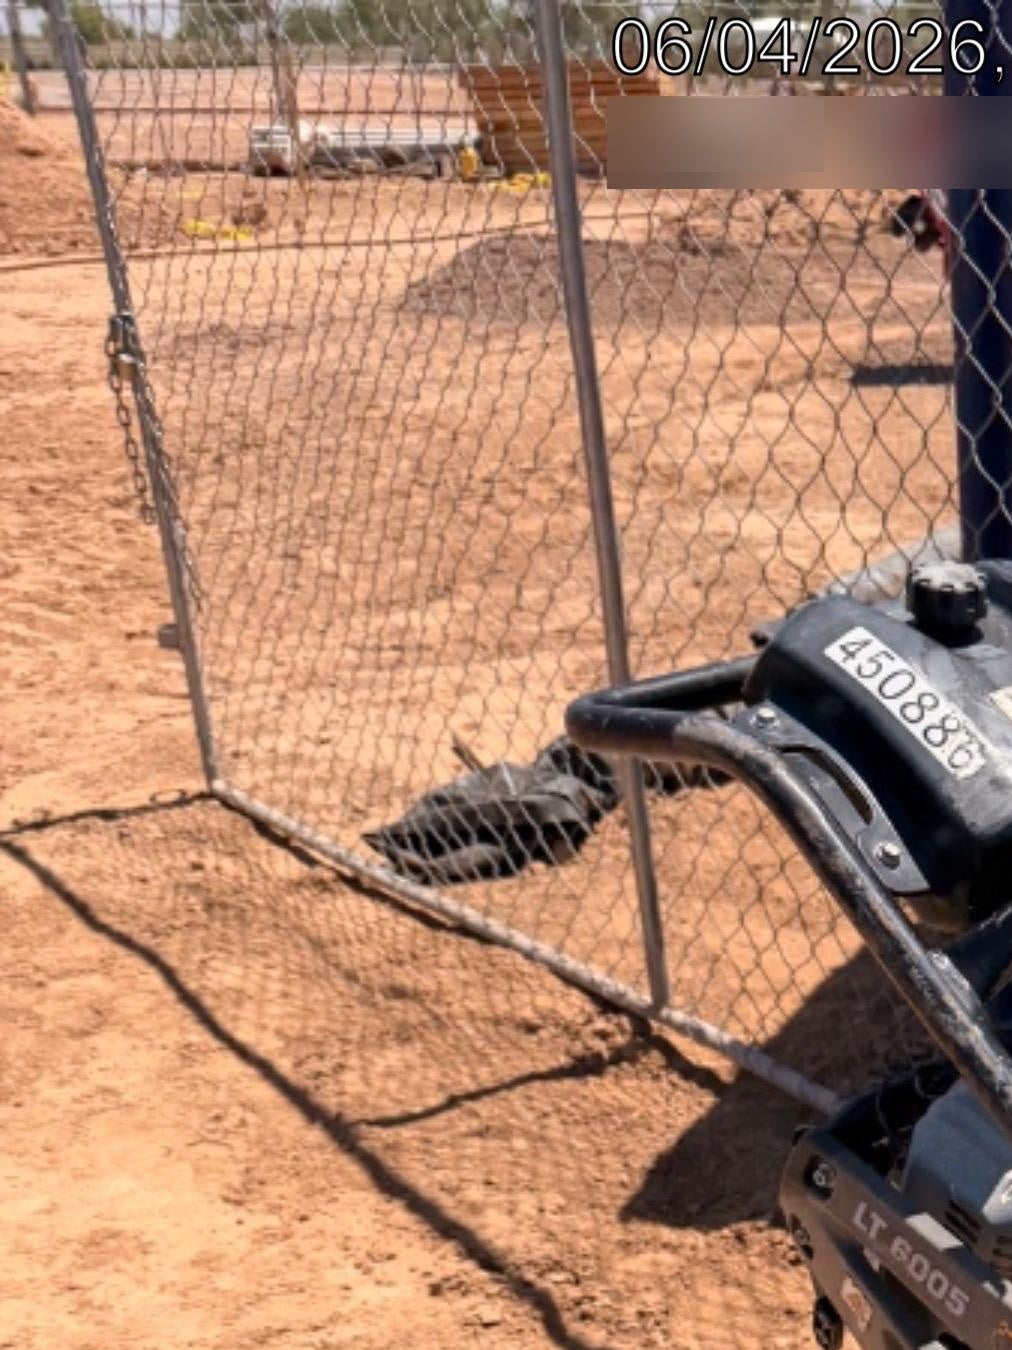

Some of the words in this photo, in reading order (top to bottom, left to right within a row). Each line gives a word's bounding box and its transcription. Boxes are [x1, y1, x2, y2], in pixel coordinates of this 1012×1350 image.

[839, 638, 985, 769] 450886
[853, 1202, 888, 1238] LT
[891, 1236, 970, 1315] 6005
